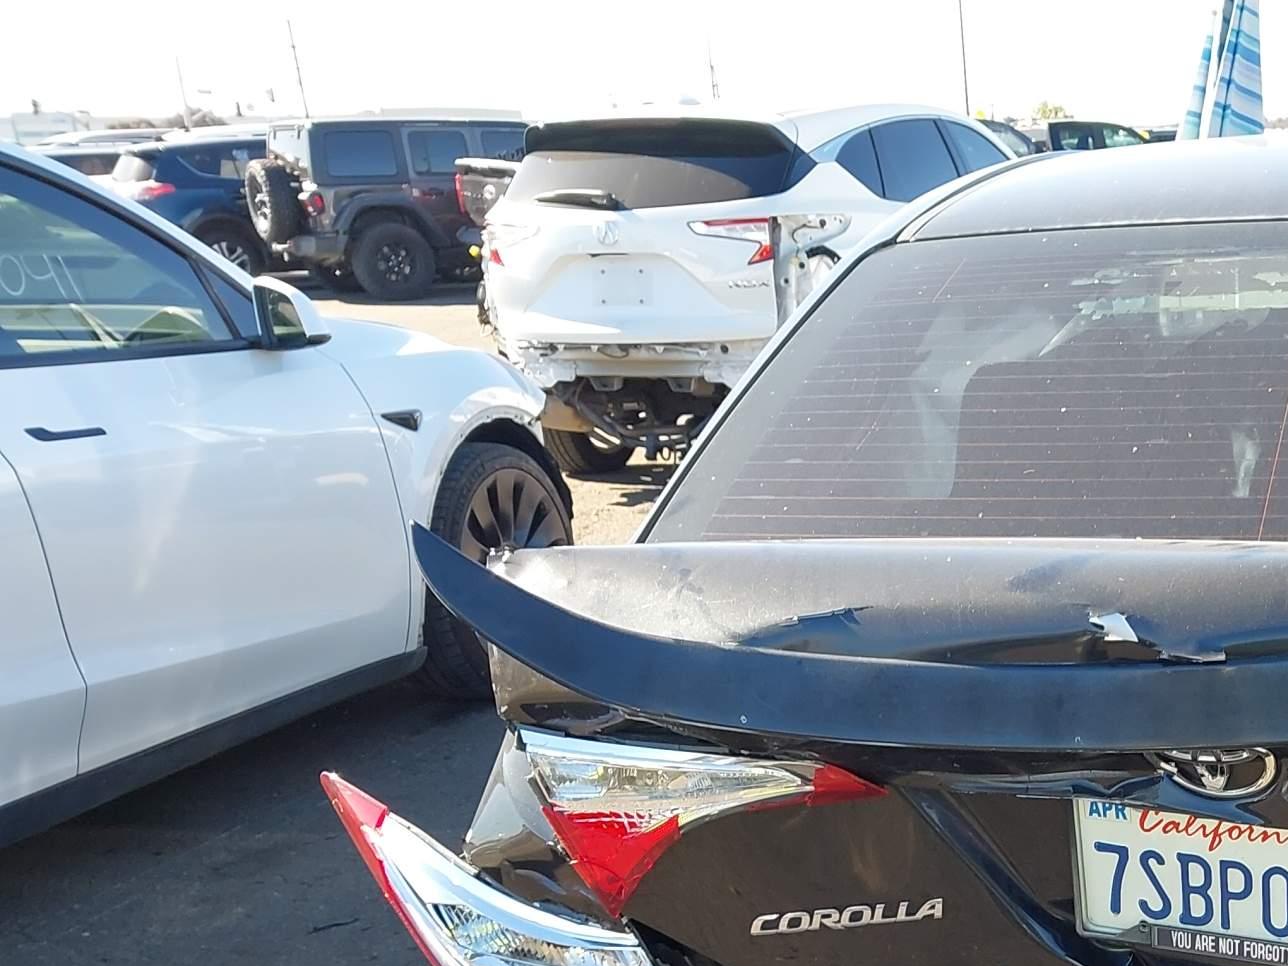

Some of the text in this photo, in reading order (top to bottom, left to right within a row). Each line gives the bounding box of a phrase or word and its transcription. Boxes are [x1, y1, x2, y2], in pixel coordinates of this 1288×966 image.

[1088, 801, 1128, 821] APR
[750, 898, 943, 936] COROLLA
[1171, 930, 1193, 949] YOU
[1195, 933, 1217, 953] ARE
[1219, 937, 1241, 957] NOT
